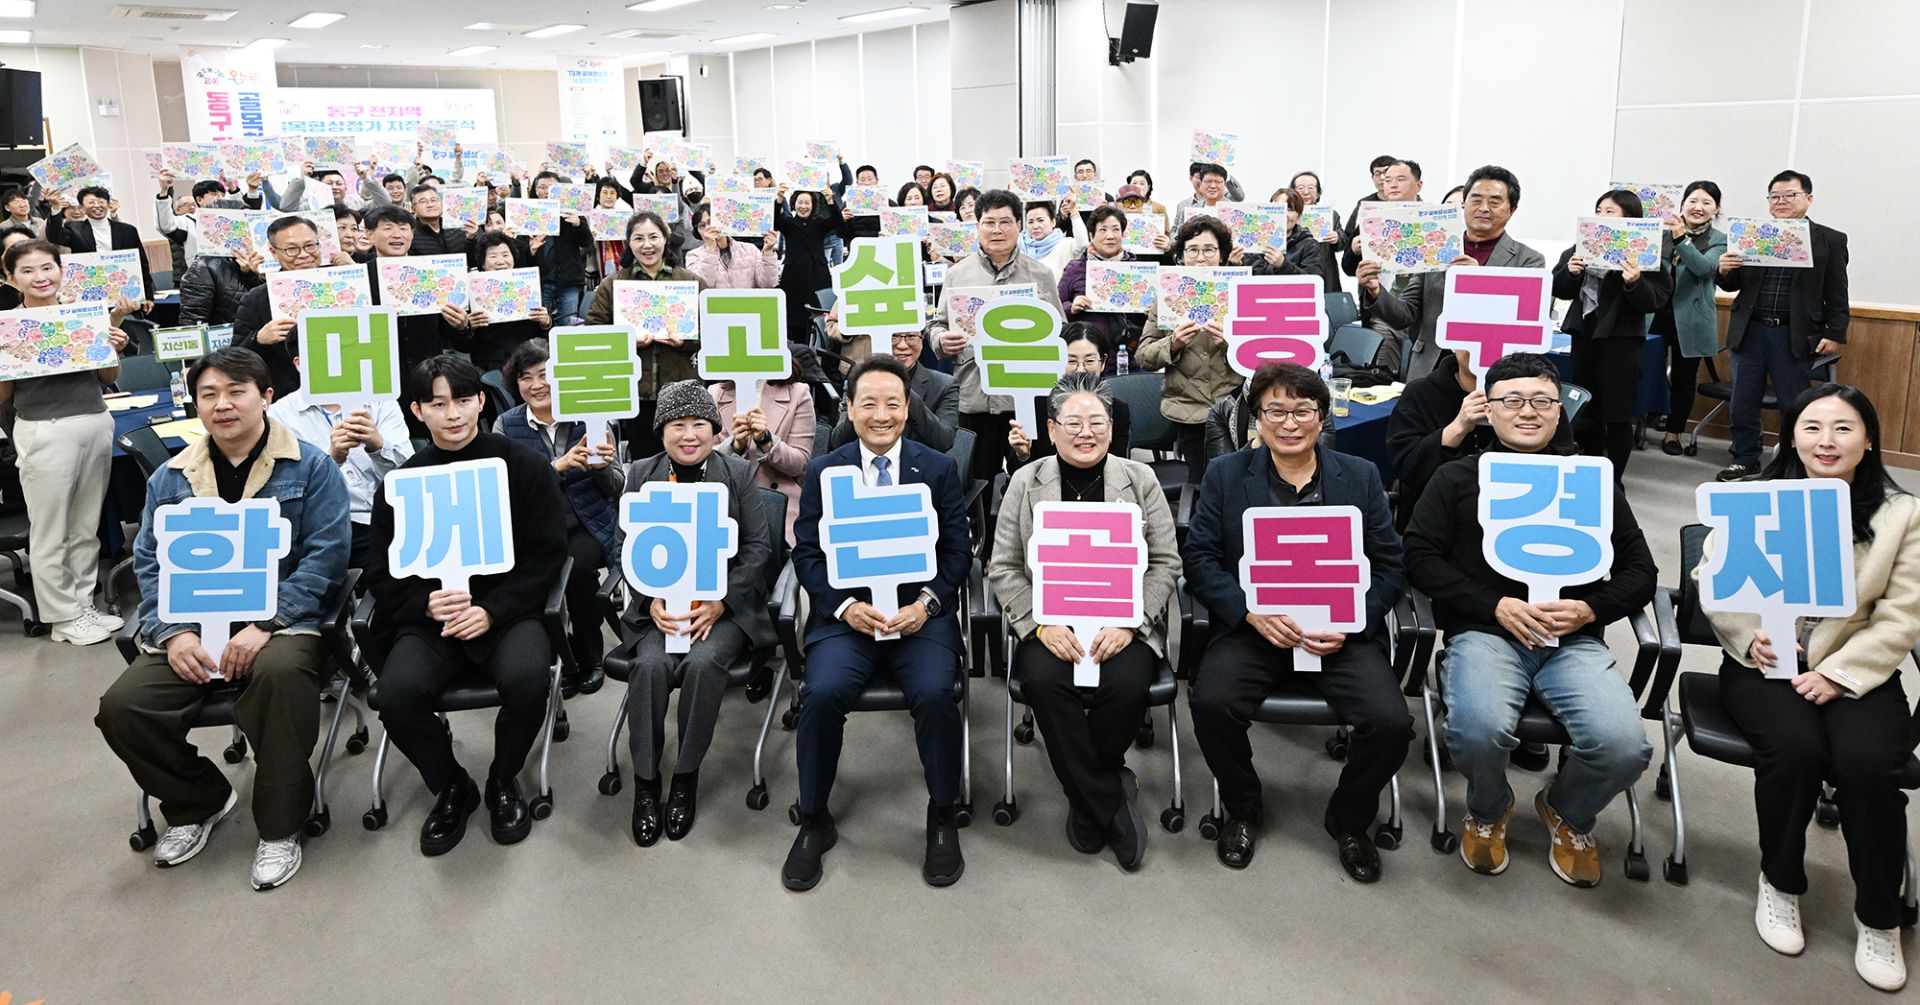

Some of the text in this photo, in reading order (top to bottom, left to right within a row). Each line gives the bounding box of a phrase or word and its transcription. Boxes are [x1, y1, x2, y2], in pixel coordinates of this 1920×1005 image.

[206, 91, 231, 132] 동구
[327, 105, 422, 118] 동구 전지역
[841, 242, 917, 327] 싶
[1232, 283, 1321, 370] 동
[1446, 274, 1543, 368] 구
[306, 314, 391, 395] 머
[553, 333, 634, 415] 물
[706, 296, 784, 372] 고
[981, 304, 1060, 388] 은
[165, 507, 281, 613] 함
[395, 466, 505, 569] 께
[629, 491, 729, 592] 하
[829, 476, 929, 579] 는
[1037, 511, 1138, 618] 골
[1490, 462, 1602, 575] 경
[1709, 489, 1844, 606] 제
[1250, 516, 1360, 623] 목
